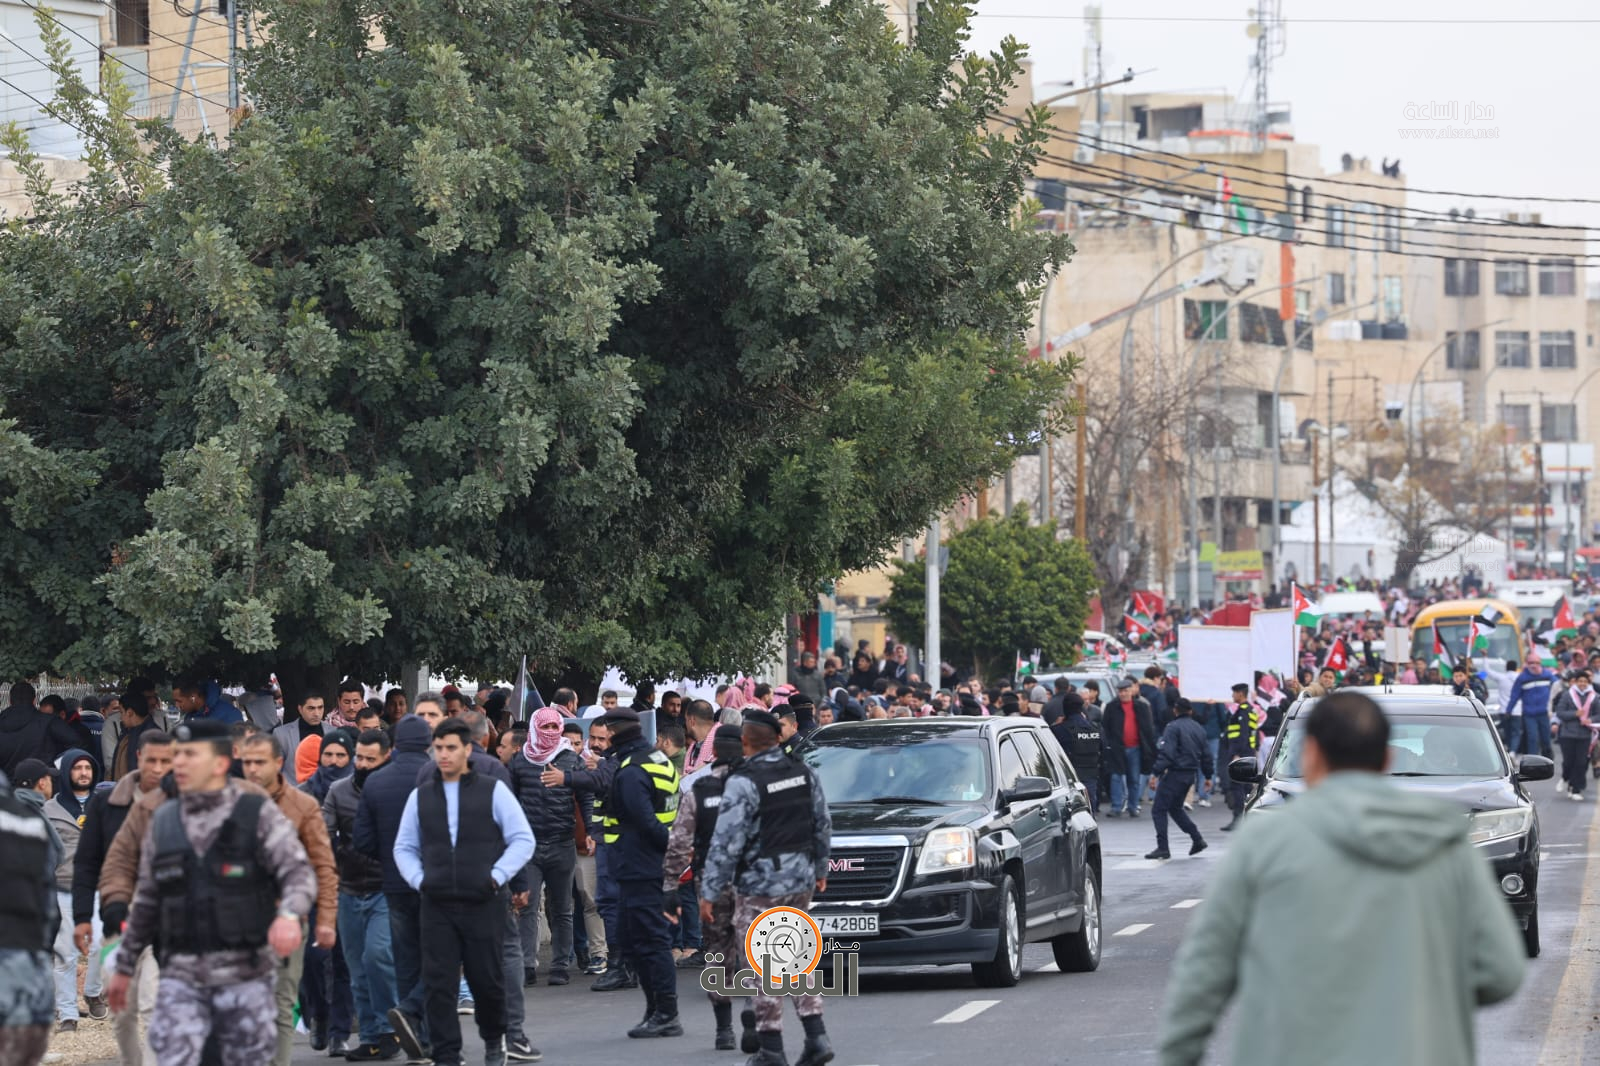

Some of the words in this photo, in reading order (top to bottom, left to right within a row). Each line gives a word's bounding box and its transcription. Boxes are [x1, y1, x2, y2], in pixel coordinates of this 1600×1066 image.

[1077, 732, 1101, 740] POLICE
[828, 858, 865, 872] MC
[818, 917, 876, 931] 7-42806
